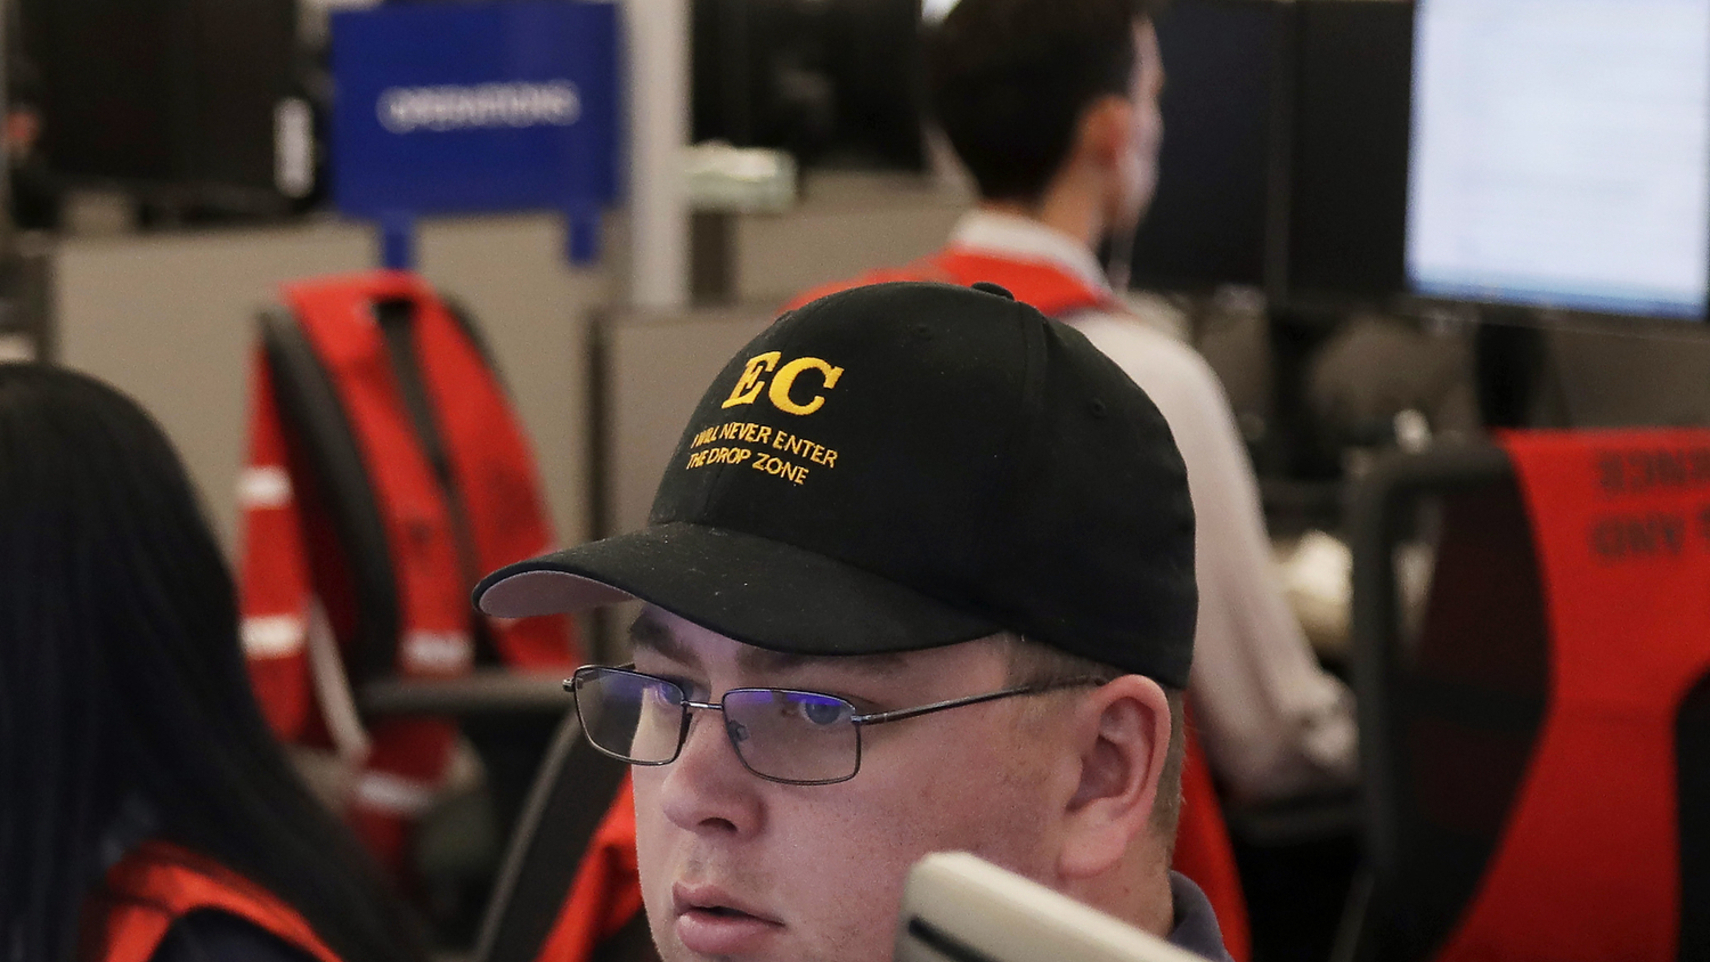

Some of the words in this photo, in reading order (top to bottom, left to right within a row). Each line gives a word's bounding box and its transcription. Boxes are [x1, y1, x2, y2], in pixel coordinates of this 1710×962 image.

[721, 351, 844, 415] EC
[686, 450, 709, 470] THE
[706, 447, 752, 465] DROP
[752, 452, 810, 485] ZONE
[718, 422, 772, 444] NEVER
[772, 430, 839, 469] ENTER
